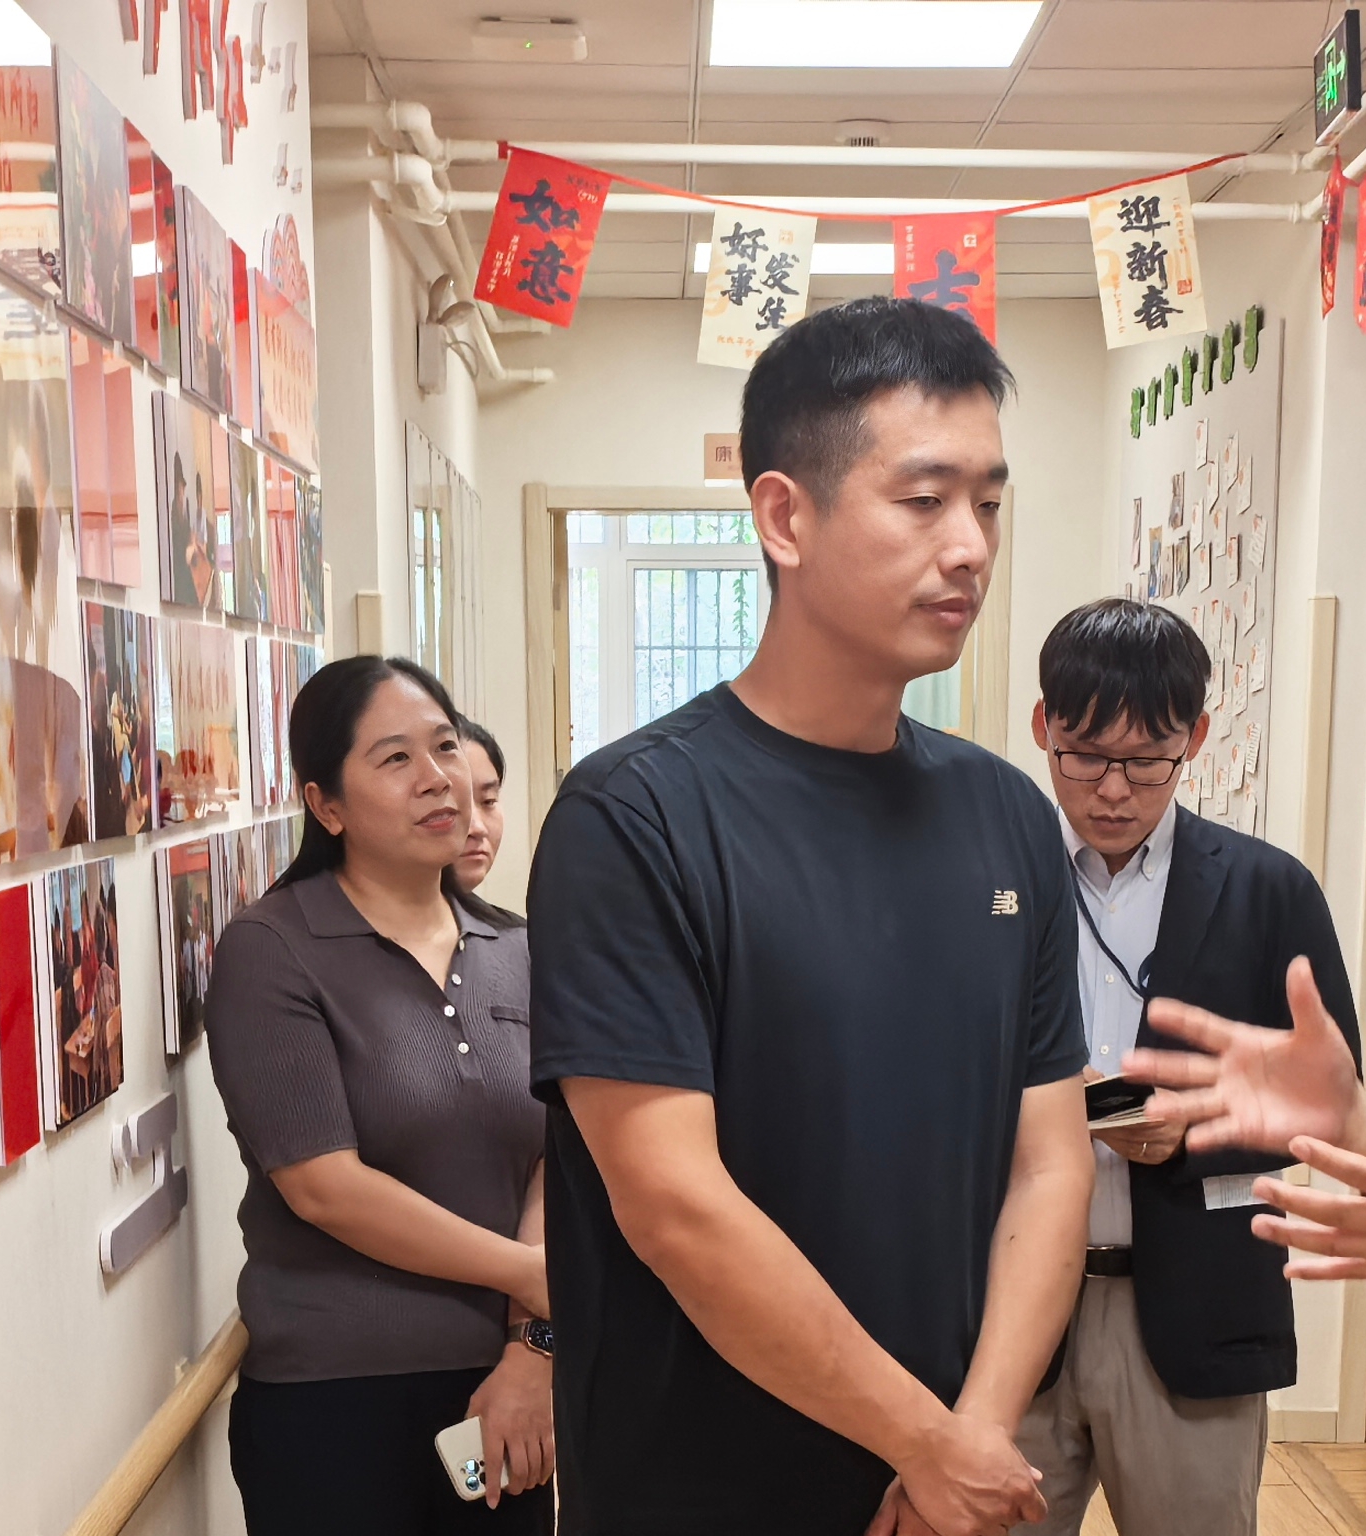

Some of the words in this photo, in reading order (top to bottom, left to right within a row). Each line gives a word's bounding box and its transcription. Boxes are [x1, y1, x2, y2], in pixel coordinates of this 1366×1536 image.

[509, 178, 580, 306] 如意
[1117, 195, 1184, 331] 迎新春
